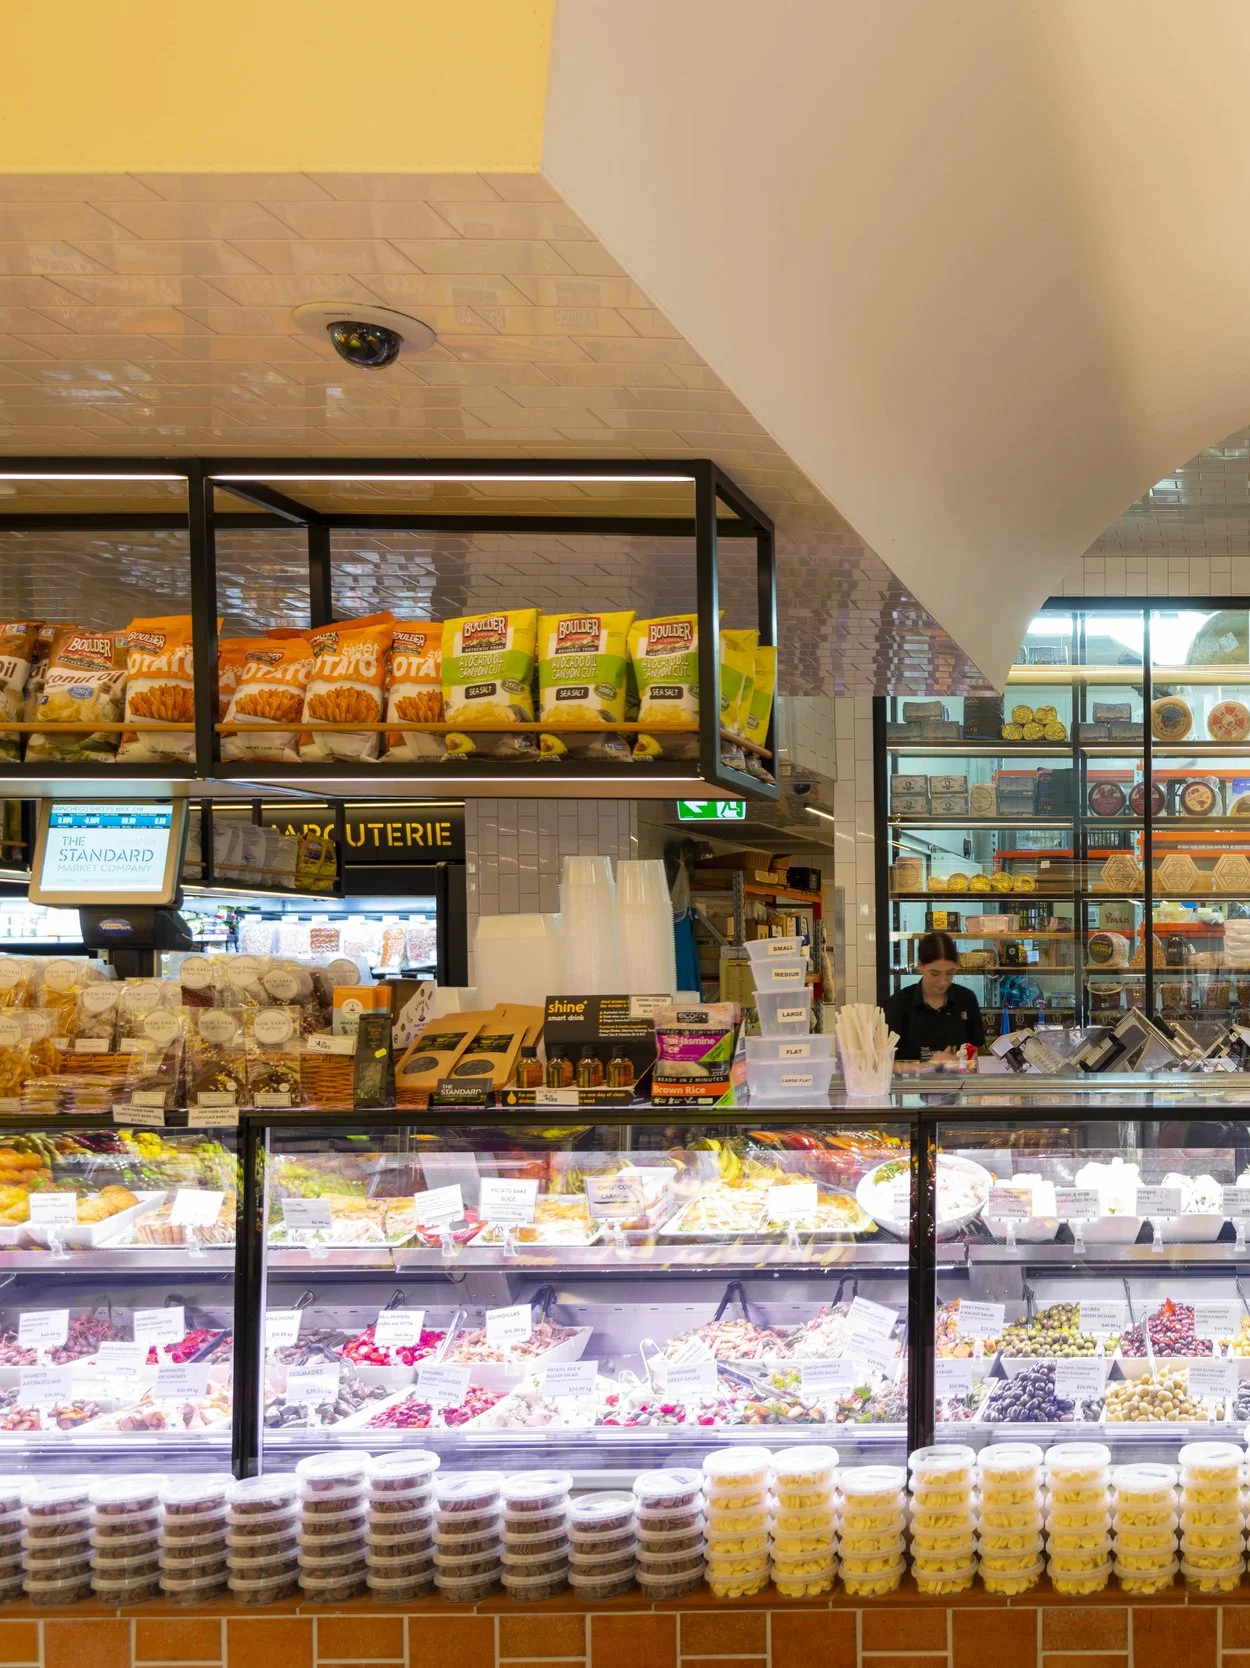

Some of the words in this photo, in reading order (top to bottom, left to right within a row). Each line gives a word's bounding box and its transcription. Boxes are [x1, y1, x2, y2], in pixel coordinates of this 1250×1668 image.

[465, 617, 506, 637] BOULDER
[559, 619, 600, 639] BOULDER
[649, 622, 691, 643] BOULDER
[129, 632, 165, 648] BOULDER
[69, 638, 112, 658] BOULDER
[480, 686, 492, 694] SALT
[572, 689, 584, 697] SALT
[664, 689, 678, 697] SALT
[62, 836, 87, 847] THE
[58, 848, 155, 862] STANDARD
[57, 864, 97, 873] MARKET
[100, 864, 152, 873] COMPANY
[782, 1010, 803, 1018] LARGE
[786, 1048, 803, 1056] FLAT
[652, 1085, 683, 1095] Brown
[685, 1085, 707, 1095] Rice
